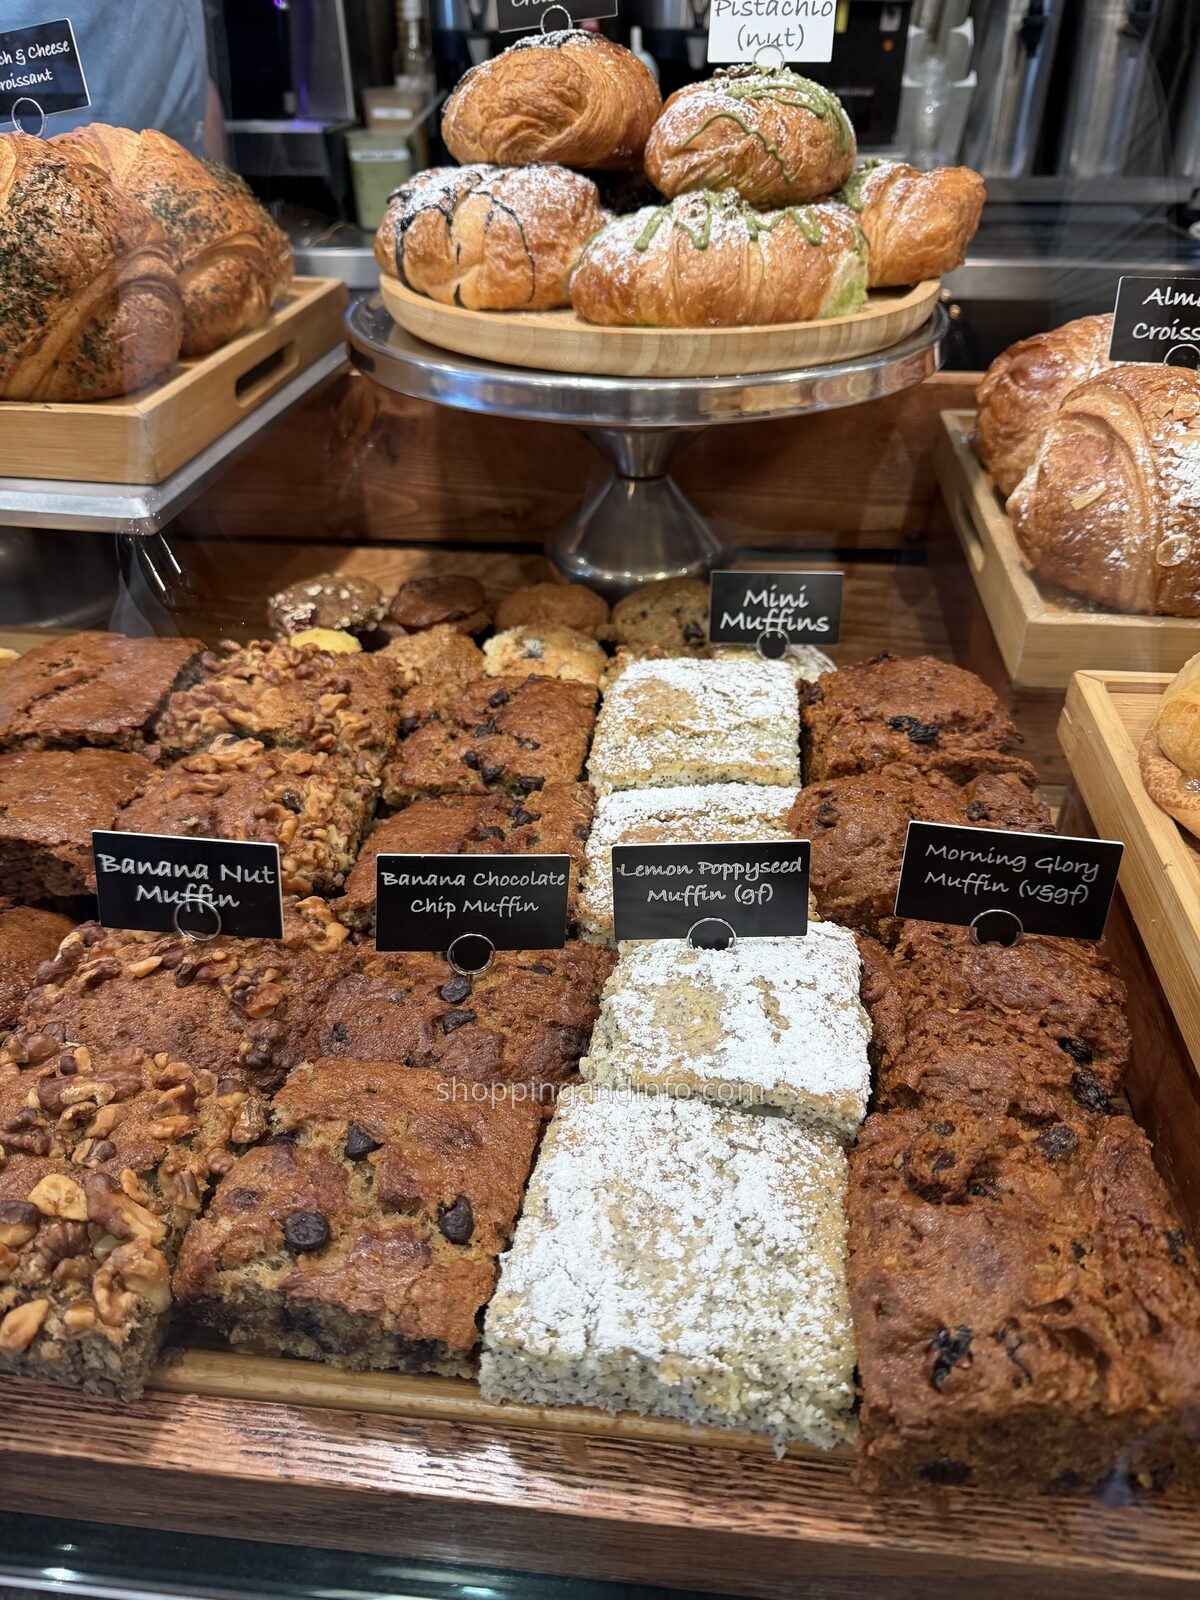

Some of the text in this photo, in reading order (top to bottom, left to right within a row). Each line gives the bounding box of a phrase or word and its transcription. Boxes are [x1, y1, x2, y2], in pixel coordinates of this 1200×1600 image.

[737, 23, 805, 52] (nut)
[15, 48, 26, 66] &
[27, 40, 70, 59] Cheese
[0, 68, 54, 91] roissant
[743, 584, 810, 608] Mini
[720, 607, 830, 639] Muffins
[97, 853, 275, 884] Banana Nut
[620, 856, 802, 882] Lemon Poppyseed
[924, 843, 1100, 883] Morning Glory
[380, 870, 566, 887] Banana Chocolate
[923, 871, 1090, 907] Muffin (v&gf)
[136, 882, 241, 914] Muffin
[410, 895, 539, 919] Chip Muffin
[646, 882, 774, 907] Muffin (gf)
